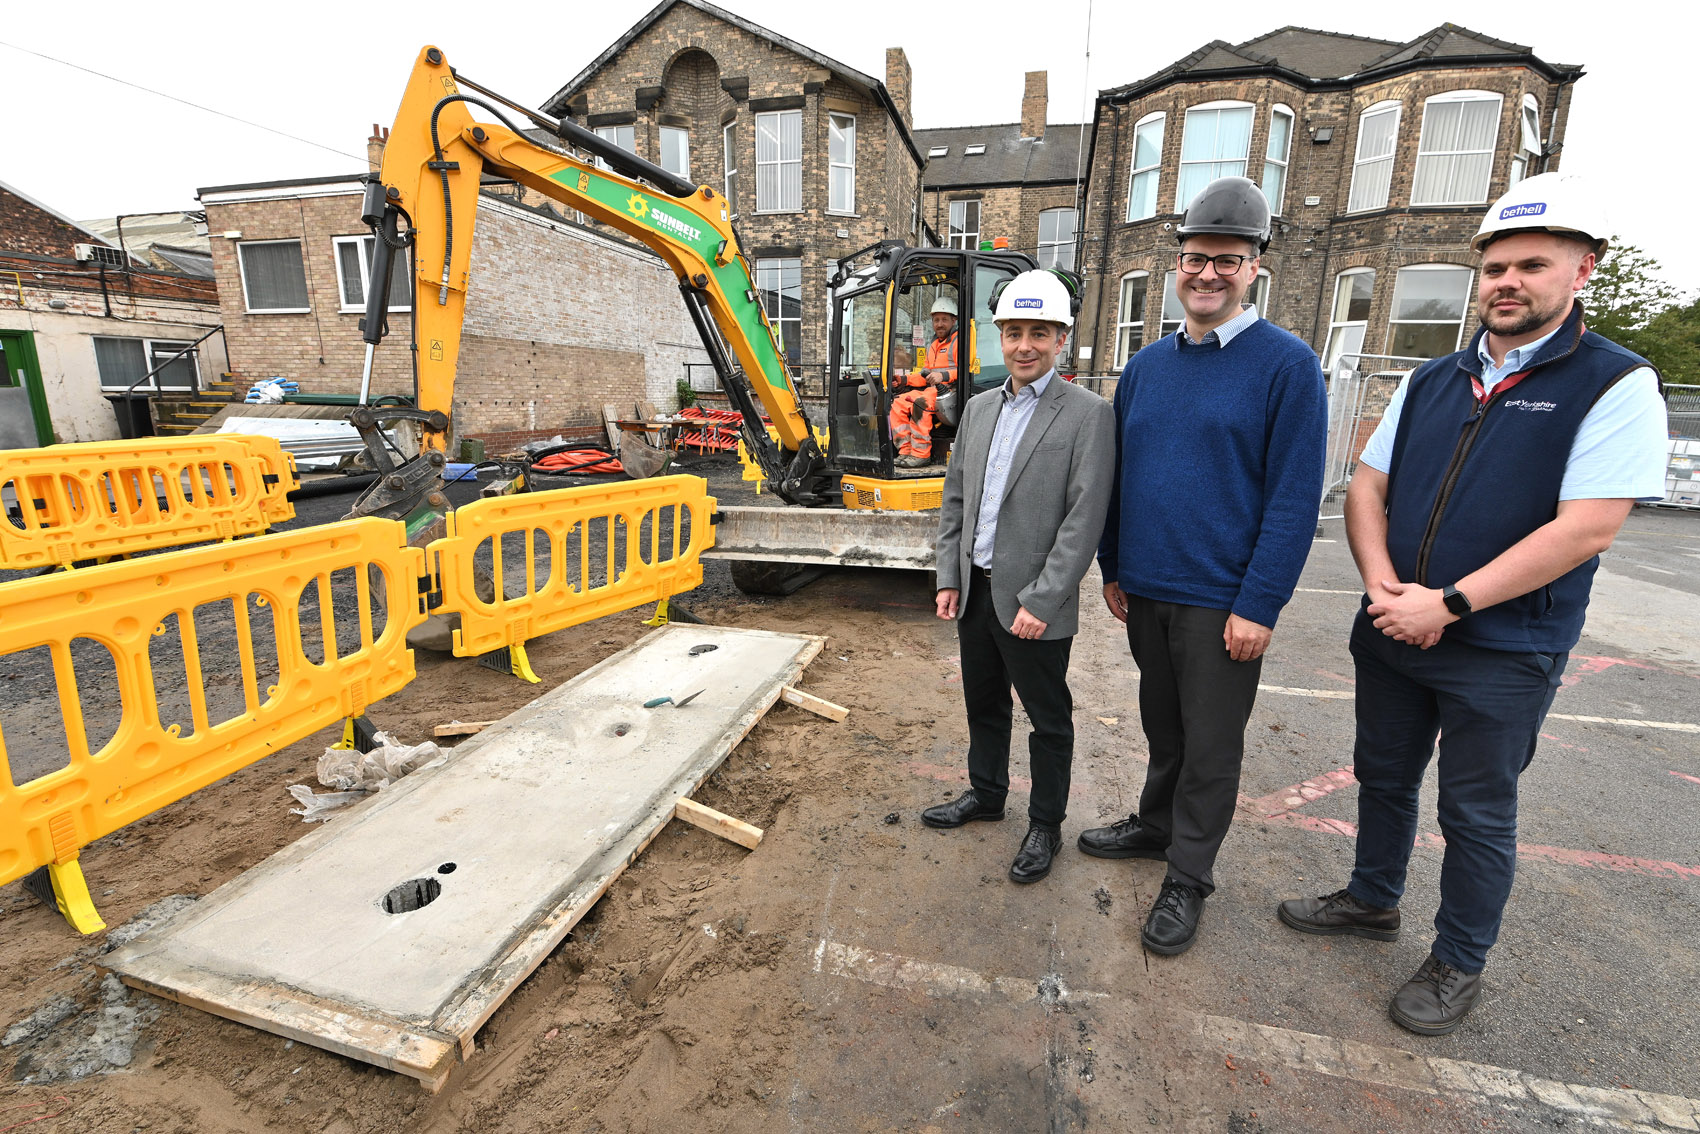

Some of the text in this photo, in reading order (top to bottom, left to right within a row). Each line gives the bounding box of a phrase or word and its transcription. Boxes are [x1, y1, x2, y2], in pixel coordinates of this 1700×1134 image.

[1502, 204, 1543, 218] bethell
[650, 207, 702, 241] SUNBELT
[656, 221, 693, 242] RENTALS
[1016, 299, 1042, 308] bethell
[842, 483, 855, 493] JCB
